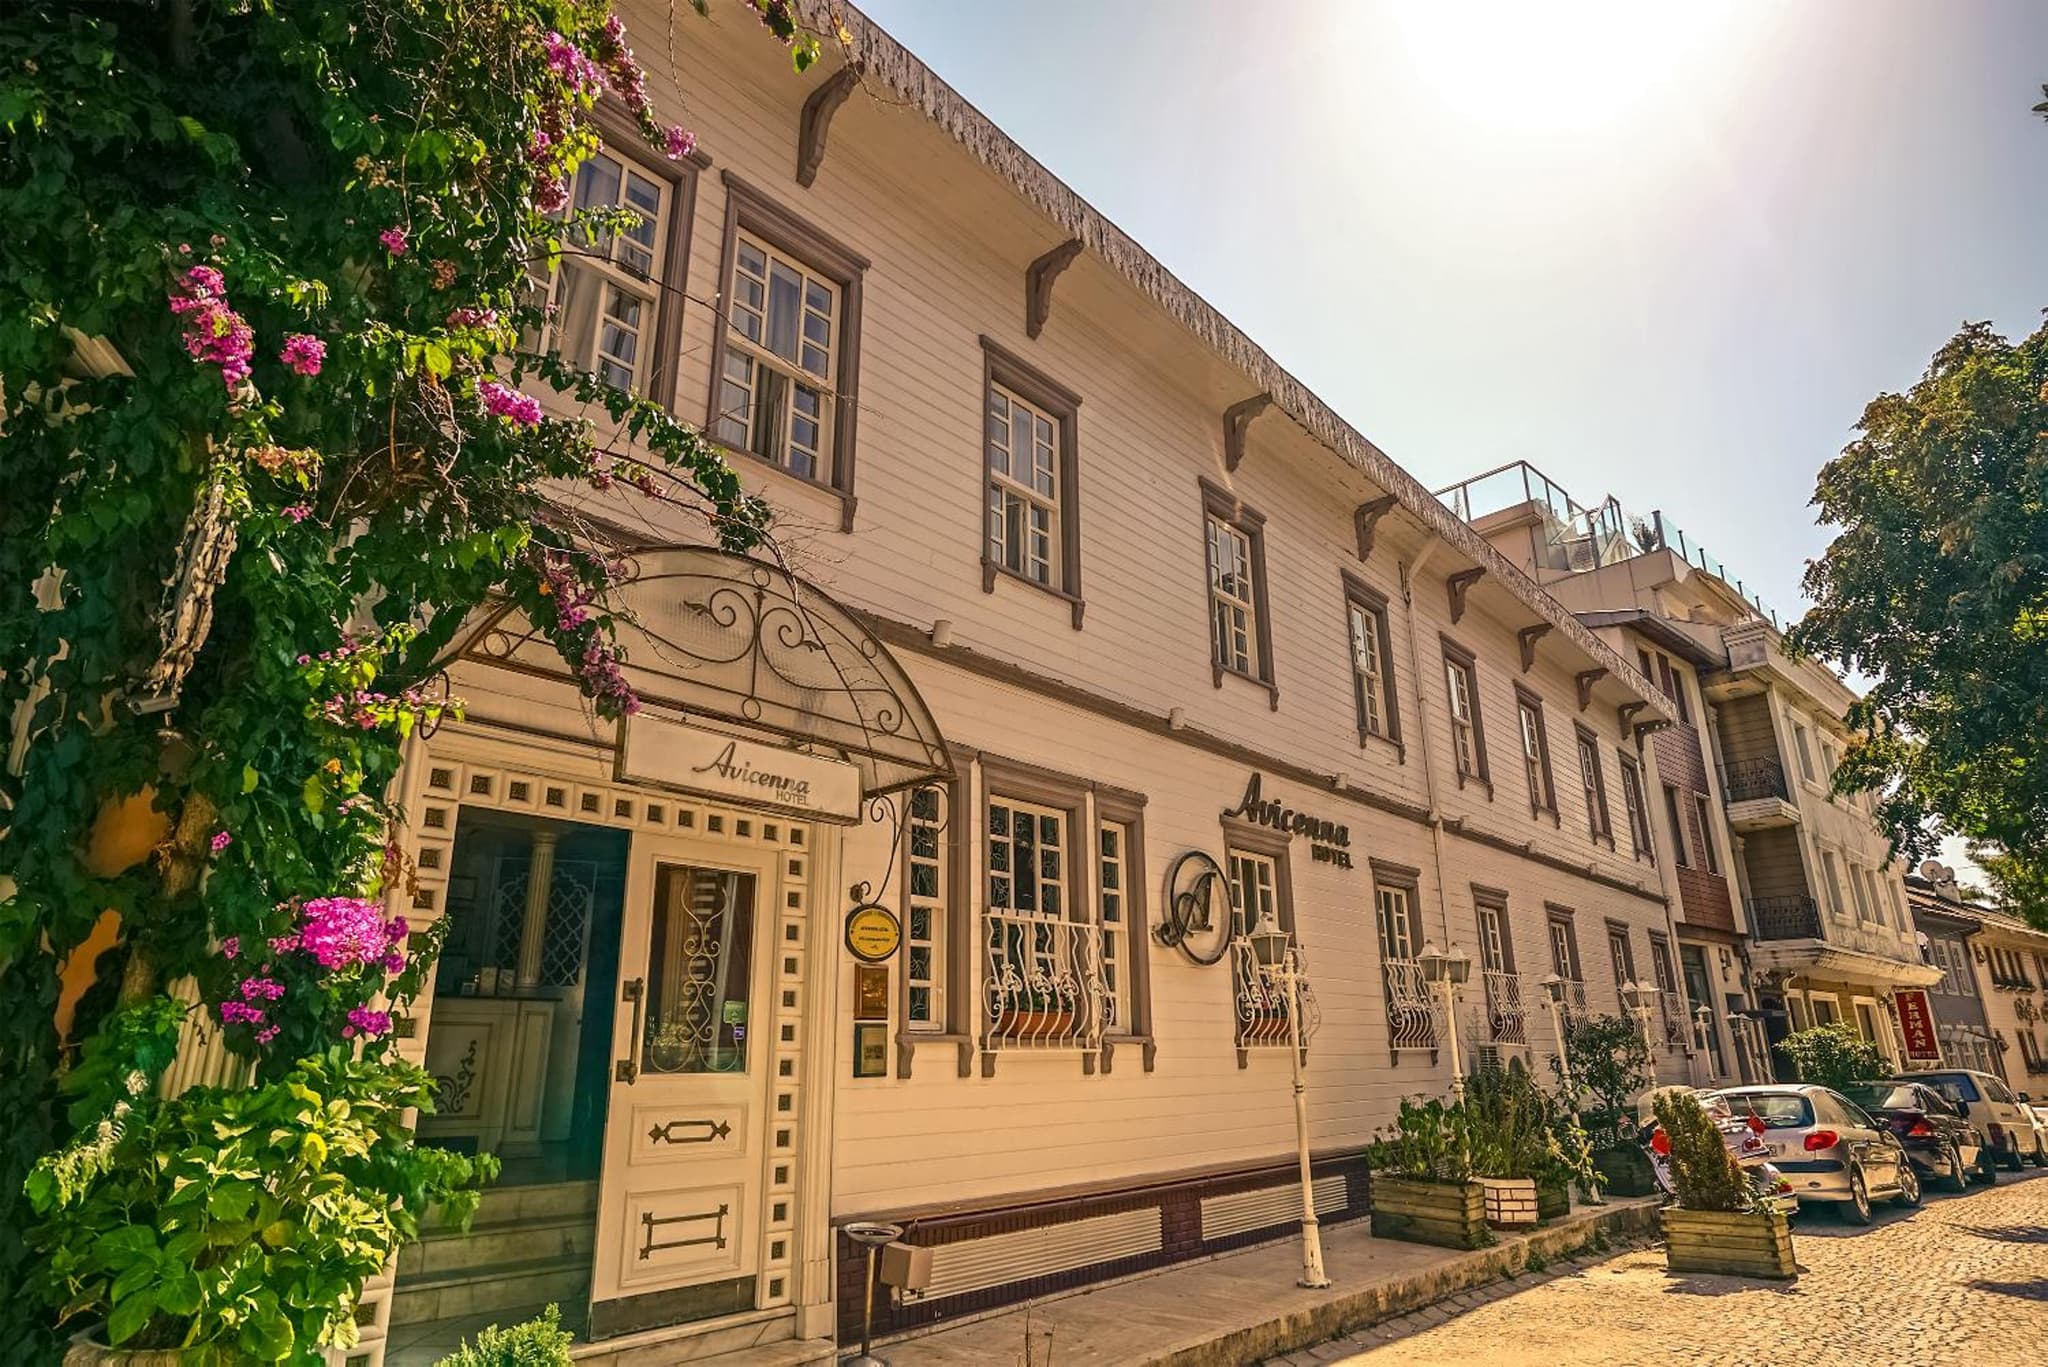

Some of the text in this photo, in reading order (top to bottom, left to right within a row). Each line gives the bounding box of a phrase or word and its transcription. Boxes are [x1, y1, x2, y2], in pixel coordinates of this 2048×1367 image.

[692, 740, 812, 794] Avicenna
[775, 789, 809, 807] HOTEL
[1224, 772, 1351, 846] Avicenna
[1311, 843, 1354, 869] HOTEL
[1906, 992, 1926, 1047] FERMAN
